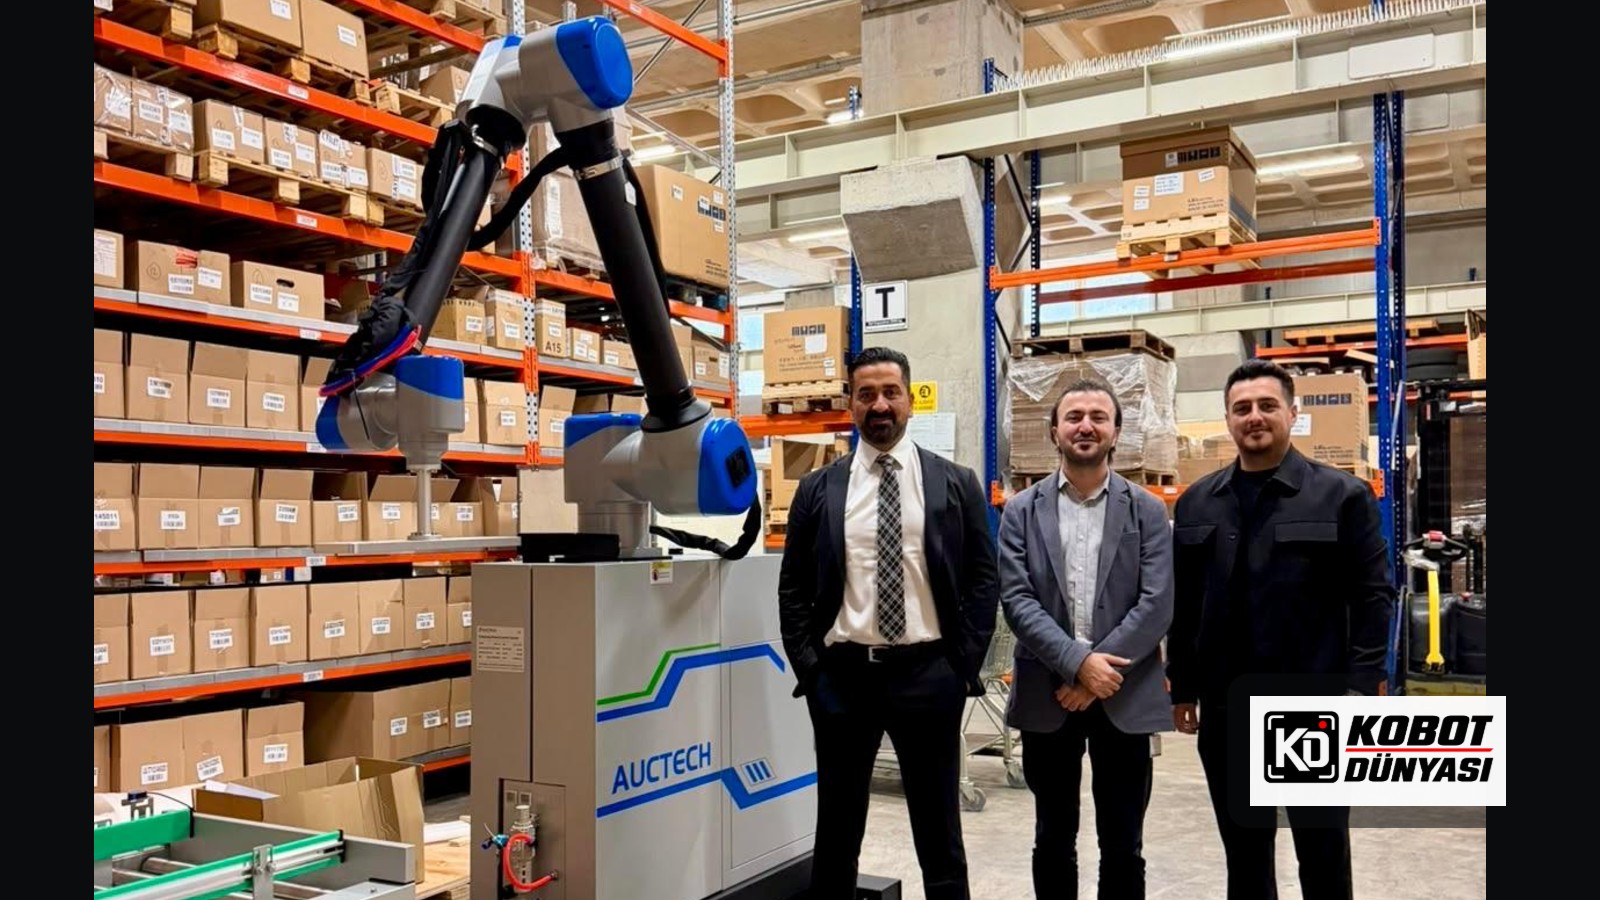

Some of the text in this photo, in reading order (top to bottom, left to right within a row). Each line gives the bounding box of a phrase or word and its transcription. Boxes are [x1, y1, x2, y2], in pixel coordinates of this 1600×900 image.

[875, 286, 895, 318] T
[545, 340, 562, 353] A15
[611, 741, 711, 795] AUCTECH
